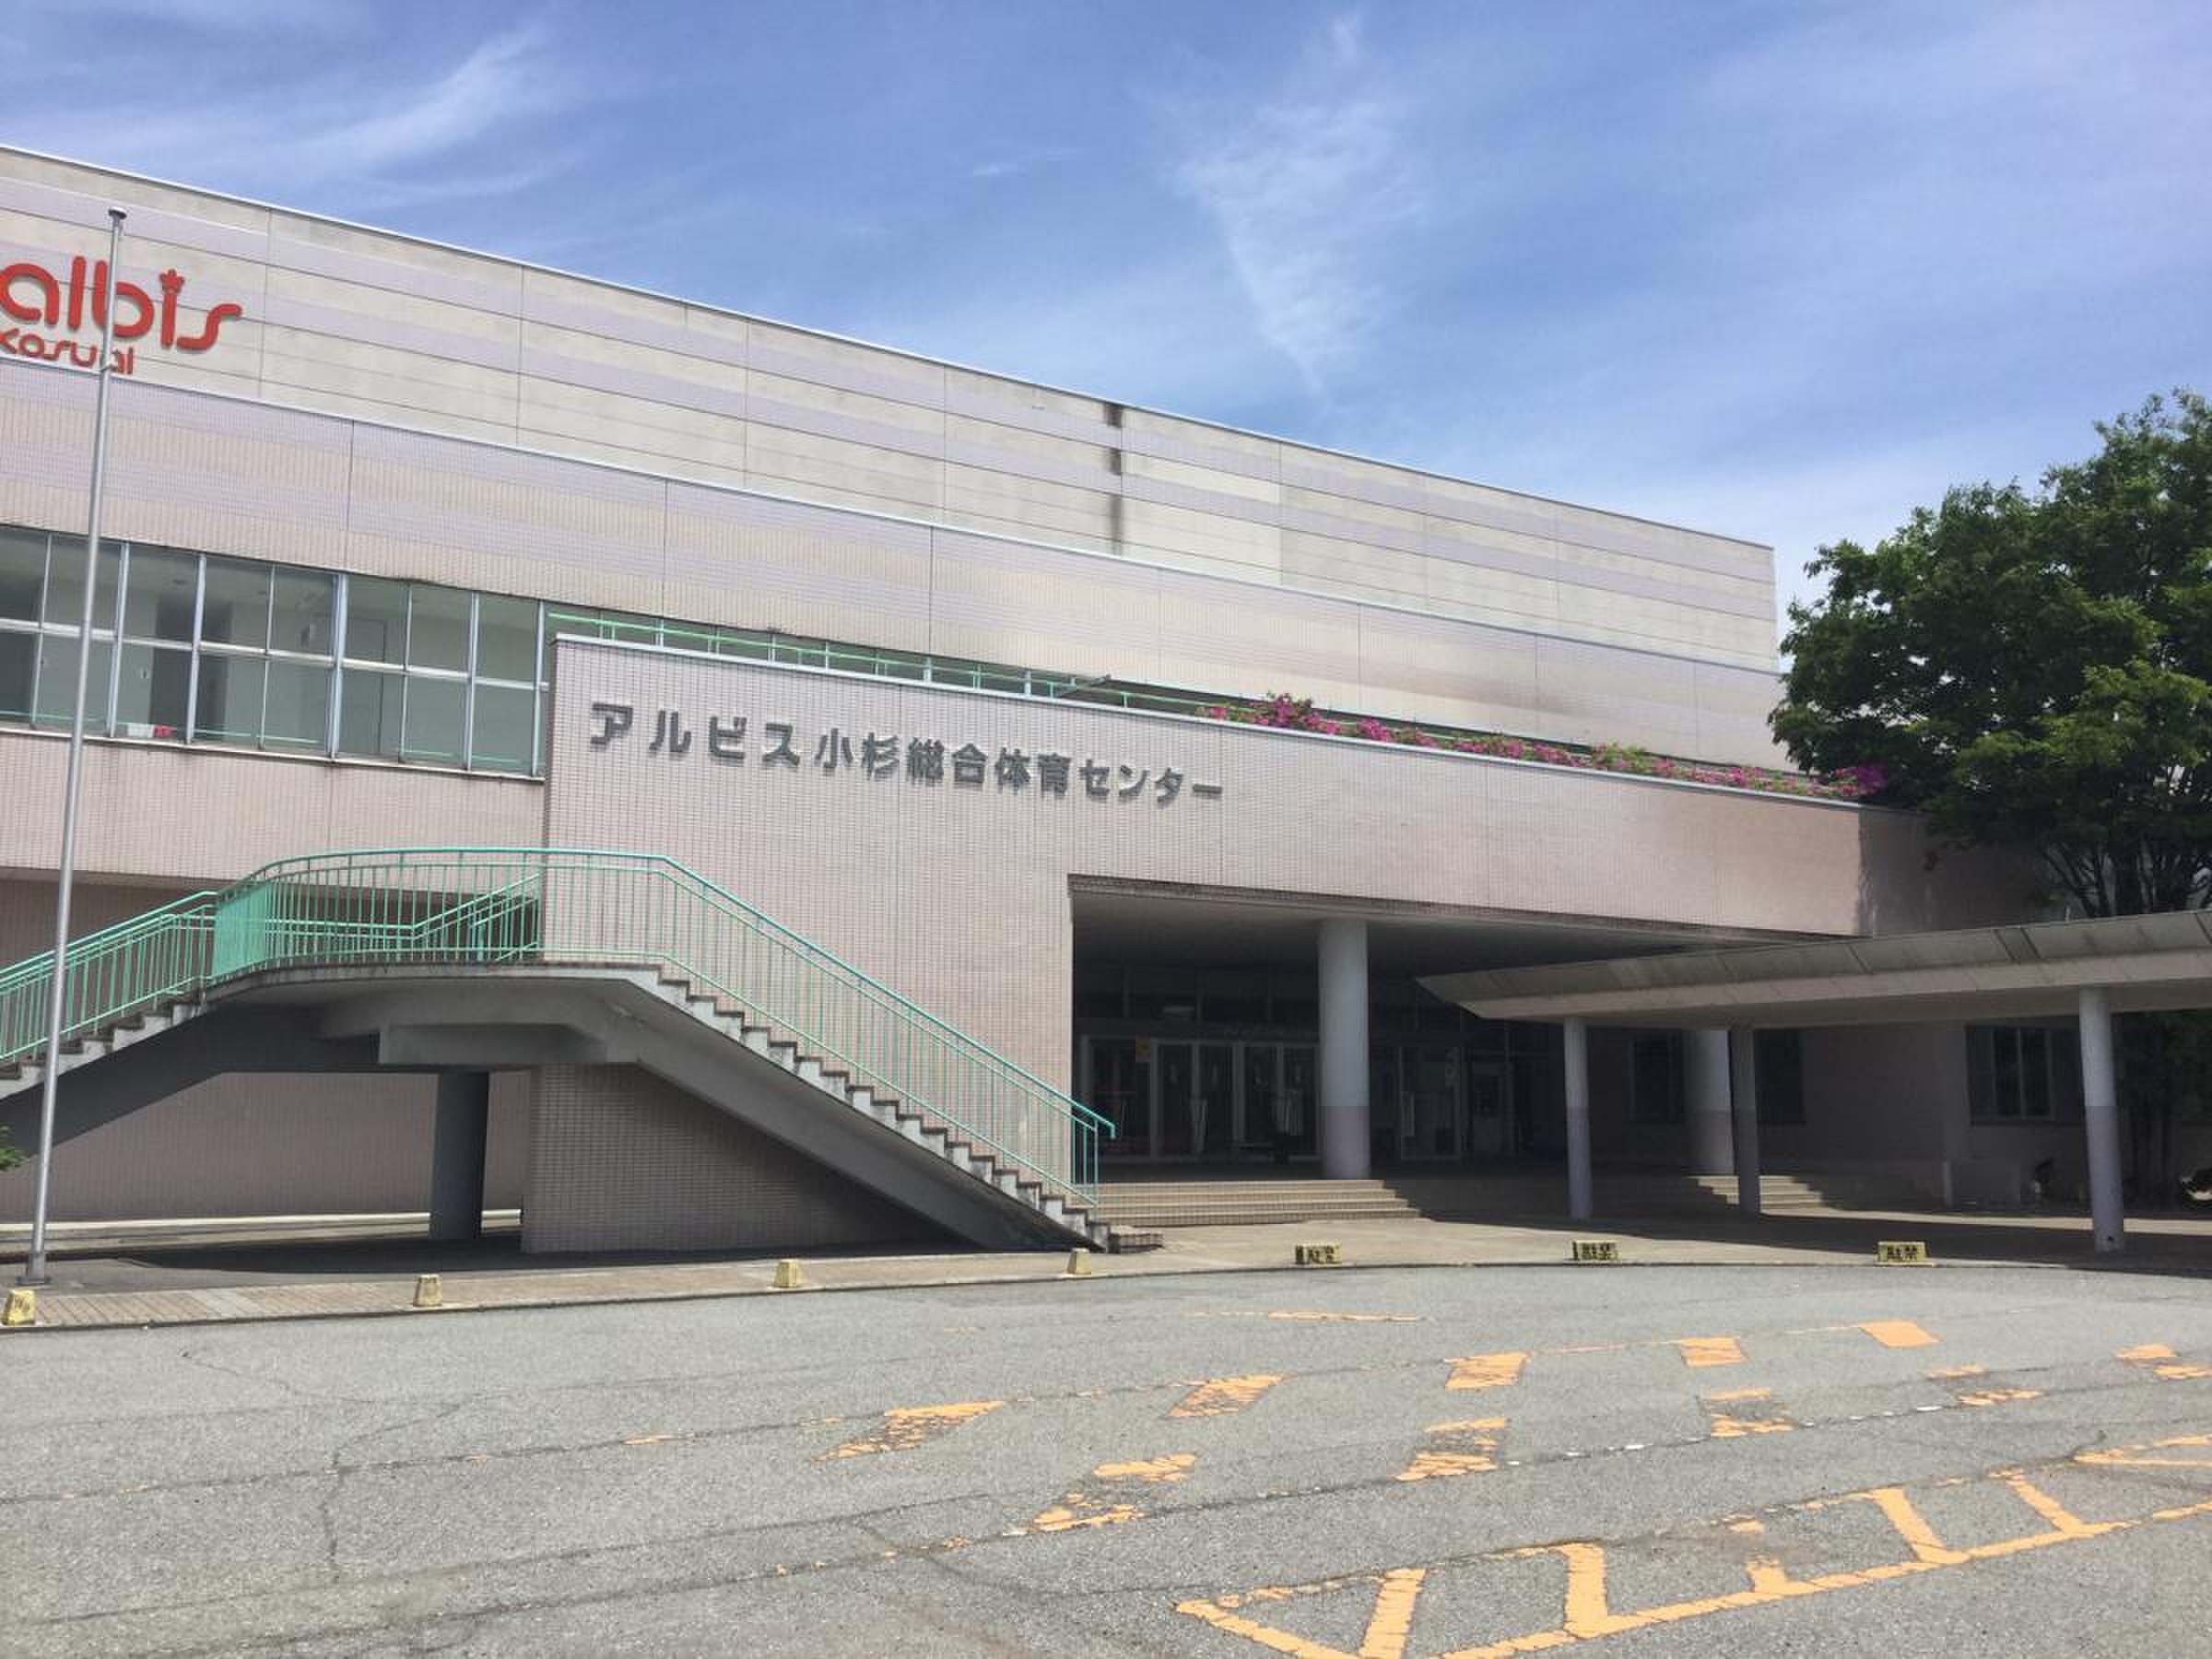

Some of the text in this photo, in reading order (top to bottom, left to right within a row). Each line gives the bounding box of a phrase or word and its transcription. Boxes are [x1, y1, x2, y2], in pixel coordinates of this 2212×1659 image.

[0, 255, 243, 350] albis
[589, 701, 1223, 805] アルビス小杉総合体育センター
